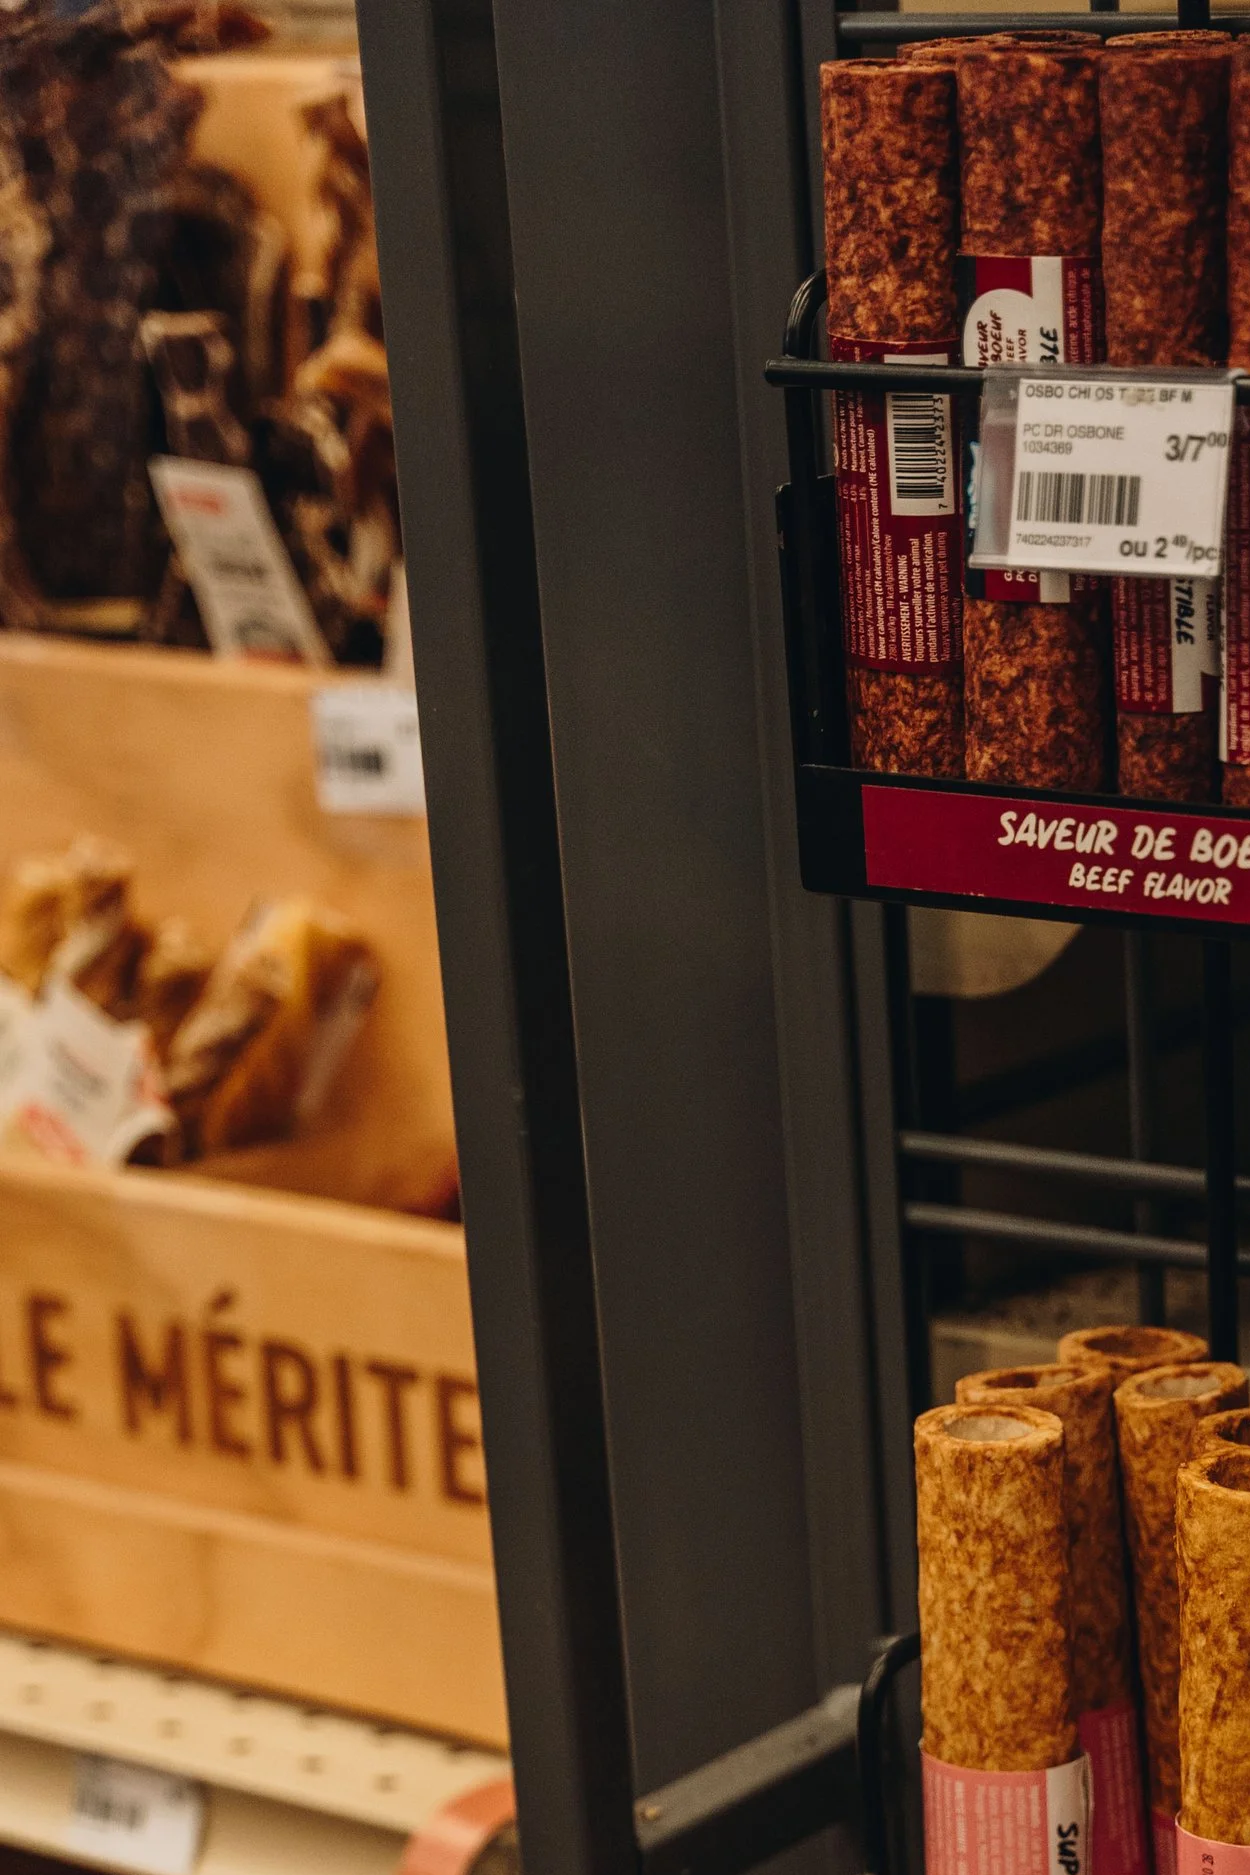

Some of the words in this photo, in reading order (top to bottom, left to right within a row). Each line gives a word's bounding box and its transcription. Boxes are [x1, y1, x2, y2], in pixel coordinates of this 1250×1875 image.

[1025, 384, 1065, 399] OSBO
[1068, 385, 1091, 400] CHI
[1095, 386, 1115, 401] OS
[1023, 423, 1042, 437] PC
[1044, 425, 1064, 438] DR
[1066, 425, 1125, 440] OSBONE
[866, 429, 877, 470] calculated)
[869, 488, 879, 516] content
[909, 538, 920, 566] animal
[922, 530, 935, 580] mastication.
[937, 531, 948, 558] during
[1120, 540, 1148, 558] ou
[1154, 538, 1168, 559] 2
[897, 555, 908, 593] WARNING
[911, 567, 921, 588] votre
[911, 591, 924, 628] surveiller
[924, 594, 937, 628] l'activité
[940, 595, 951, 632] supervise
[899, 601, 912, 662] AVERTISSEMENT
[913, 629, 926, 662] Toujours
[927, 630, 940, 662] pendant
[997, 811, 1116, 856] SAVEUR
[1131, 824, 1176, 862] DE
[1068, 863, 1134, 895] BEEF
[1143, 872, 1234, 906] FLAVOR
